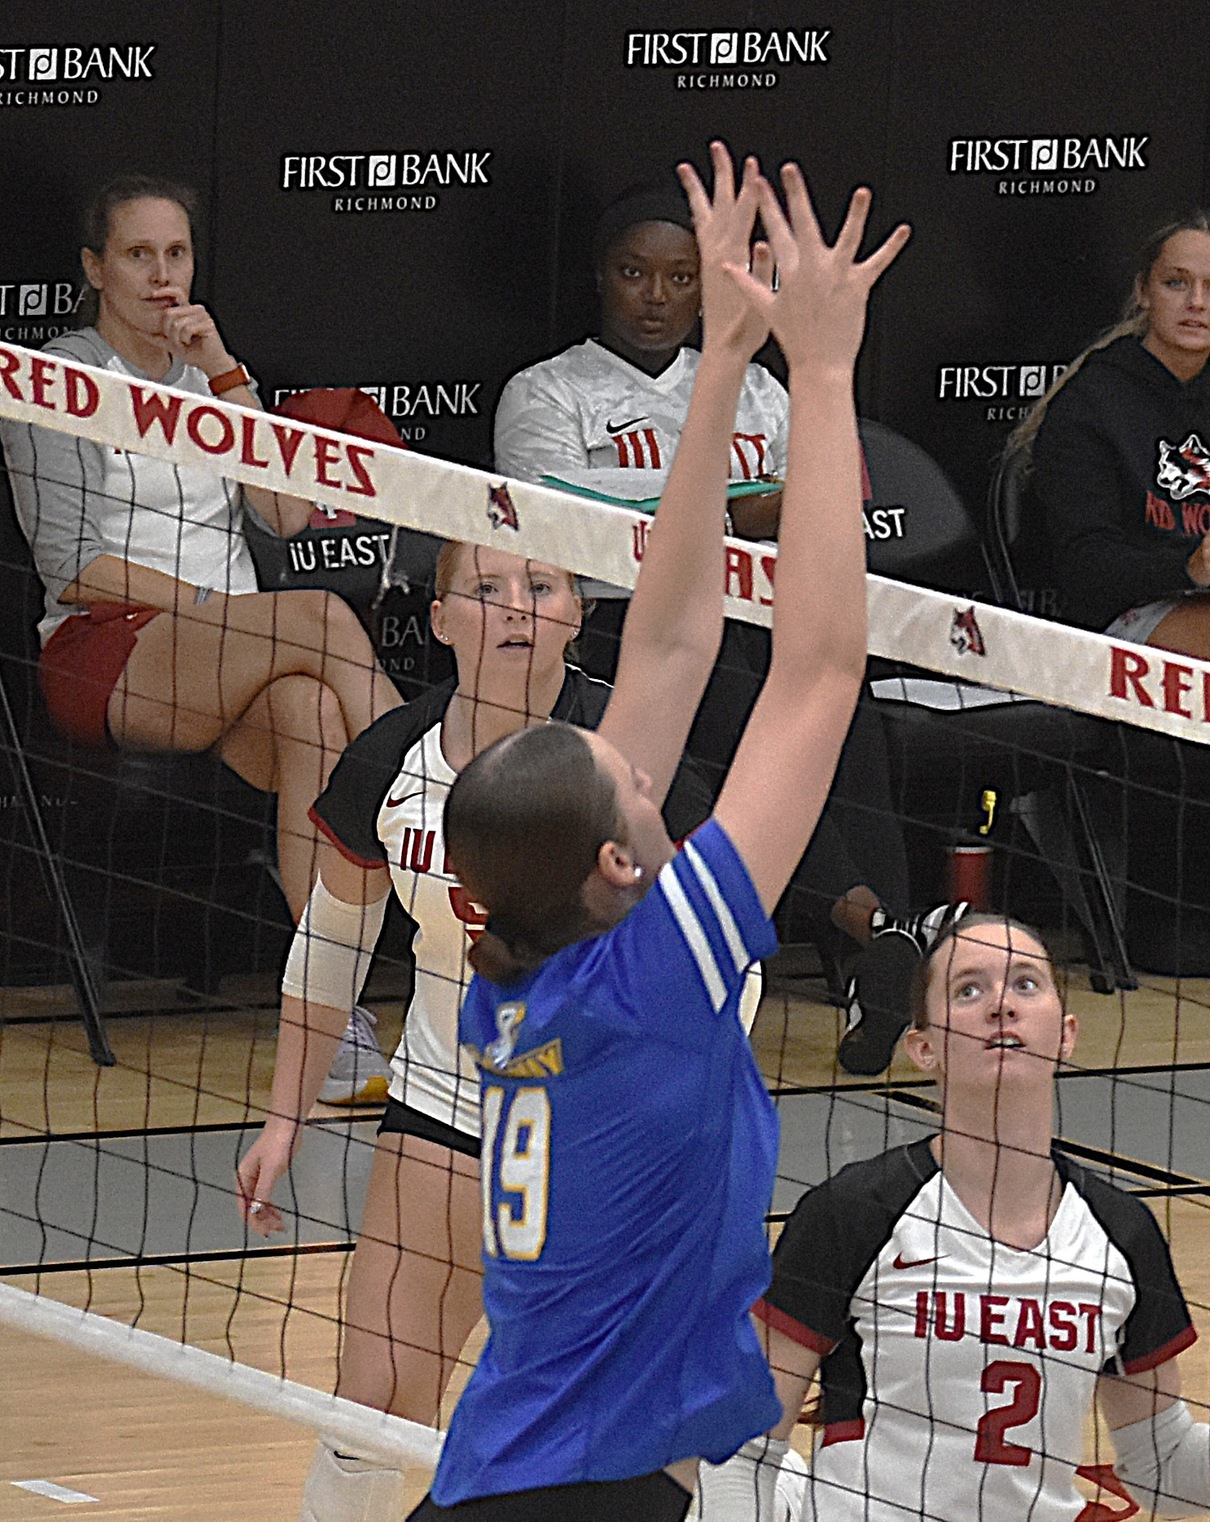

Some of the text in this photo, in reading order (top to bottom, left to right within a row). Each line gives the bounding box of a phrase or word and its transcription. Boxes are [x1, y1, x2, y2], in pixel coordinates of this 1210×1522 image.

[63, 46, 155, 79] BANK
[627, 30, 831, 65] FIRST BANK
[677, 73, 777, 88] RICHMOND
[283, 151, 492, 188] FIRST BANK
[950, 136, 1149, 171] FIRST BANK
[334, 195, 437, 212] RICHMOND
[998, 179, 1096, 194] RICHMOND
[391, 383, 481, 416] BANK
[939, 366, 1017, 398] FIRST
[0, 350, 377, 498] RED WOLVES
[290, 534, 391, 572] IU EAST
[400, 826, 437, 874] IU
[482, 1085, 553, 1262] 19
[914, 1290, 1103, 1353] IU EAST
[973, 1359, 1042, 1468] 2
